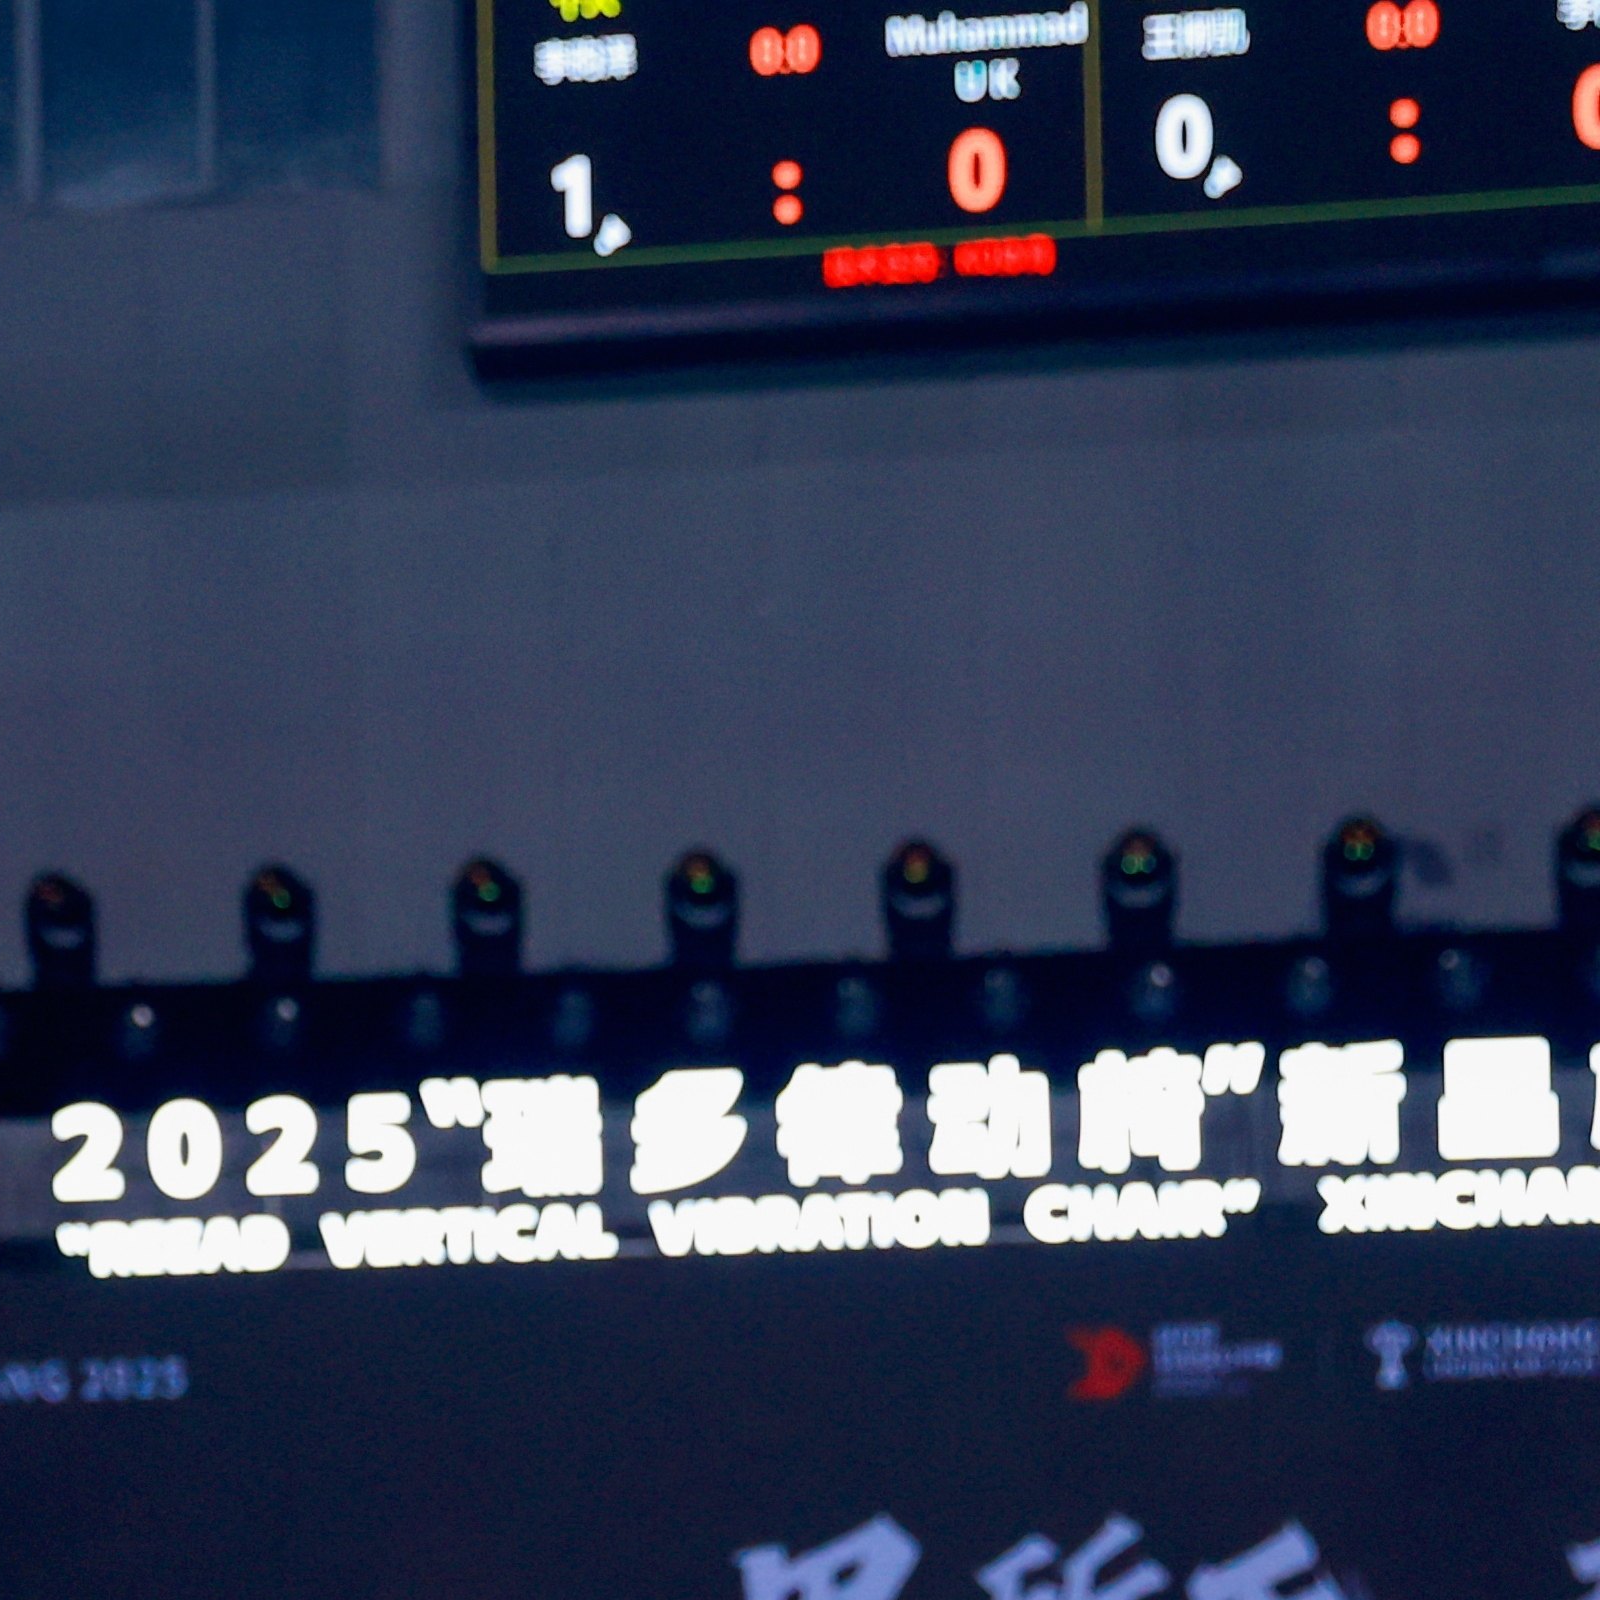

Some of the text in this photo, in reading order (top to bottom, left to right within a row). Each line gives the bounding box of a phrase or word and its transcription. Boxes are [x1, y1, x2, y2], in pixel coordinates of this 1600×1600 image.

[954, 57, 1021, 103] UK
[1155, 93, 1214, 179] 0
[551, 154, 593, 238] 1
[947, 126, 1008, 213] 0
[319, 1202, 619, 1270] VERTICAL
[647, 1188, 990, 1257] VIBRATION
